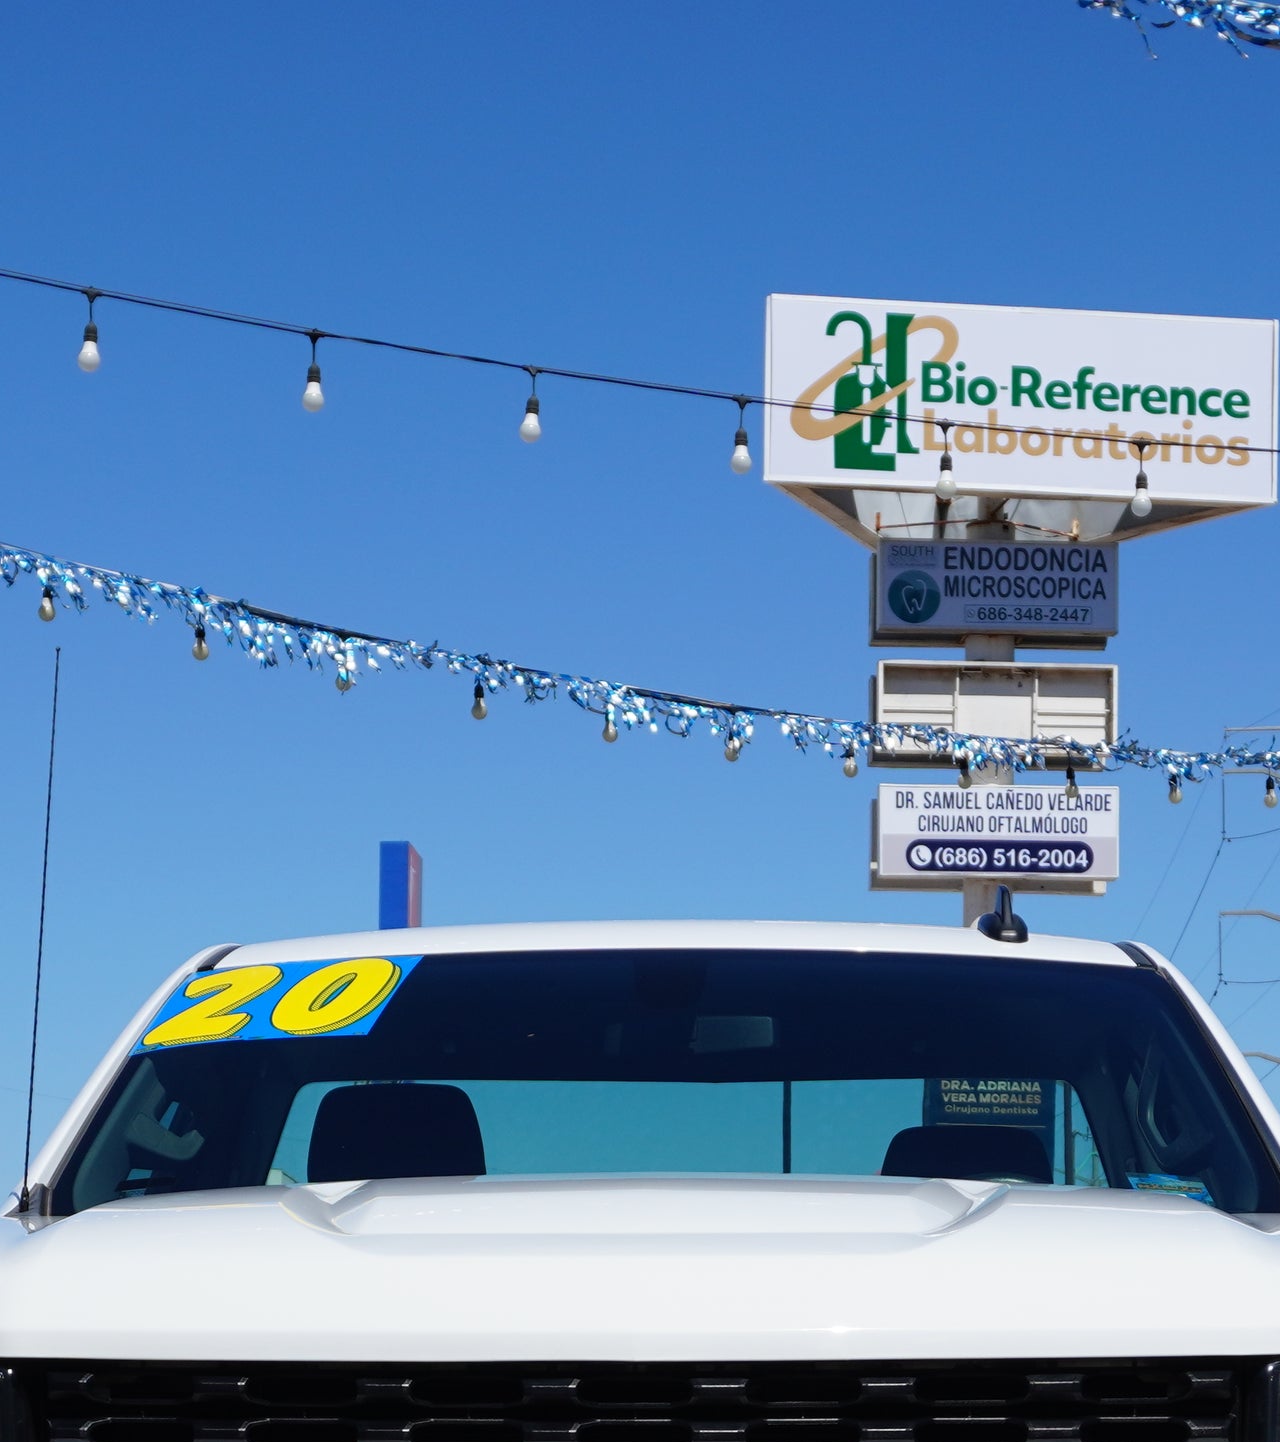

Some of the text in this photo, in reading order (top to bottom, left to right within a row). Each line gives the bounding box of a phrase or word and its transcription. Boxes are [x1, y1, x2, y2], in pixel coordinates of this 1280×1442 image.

[921, 360, 1251, 419] Bio-Reference
[922, 407, 1251, 467] Laboratorios
[891, 544, 934, 557] SOUTH
[943, 546, 1108, 574] ENDODONCIA
[943, 575, 1107, 601] MICROSCOPICA
[976, 605, 1090, 623] 686-348-2447
[895, 788, 1112, 812] DR. SAMUEL CAÑEDO VELARDE
[918, 812, 1088, 835] CIRUJANO OFTALMÓLOGO
[934, 848, 1089, 869] (686) 516-2004
[142, 957, 402, 1047] 20
[941, 1079, 1042, 1092] DRA. ADRIANA
[942, 1092, 1042, 1105] VERA MORALES
[944, 1103, 1039, 1115] Cirujano Dentista
